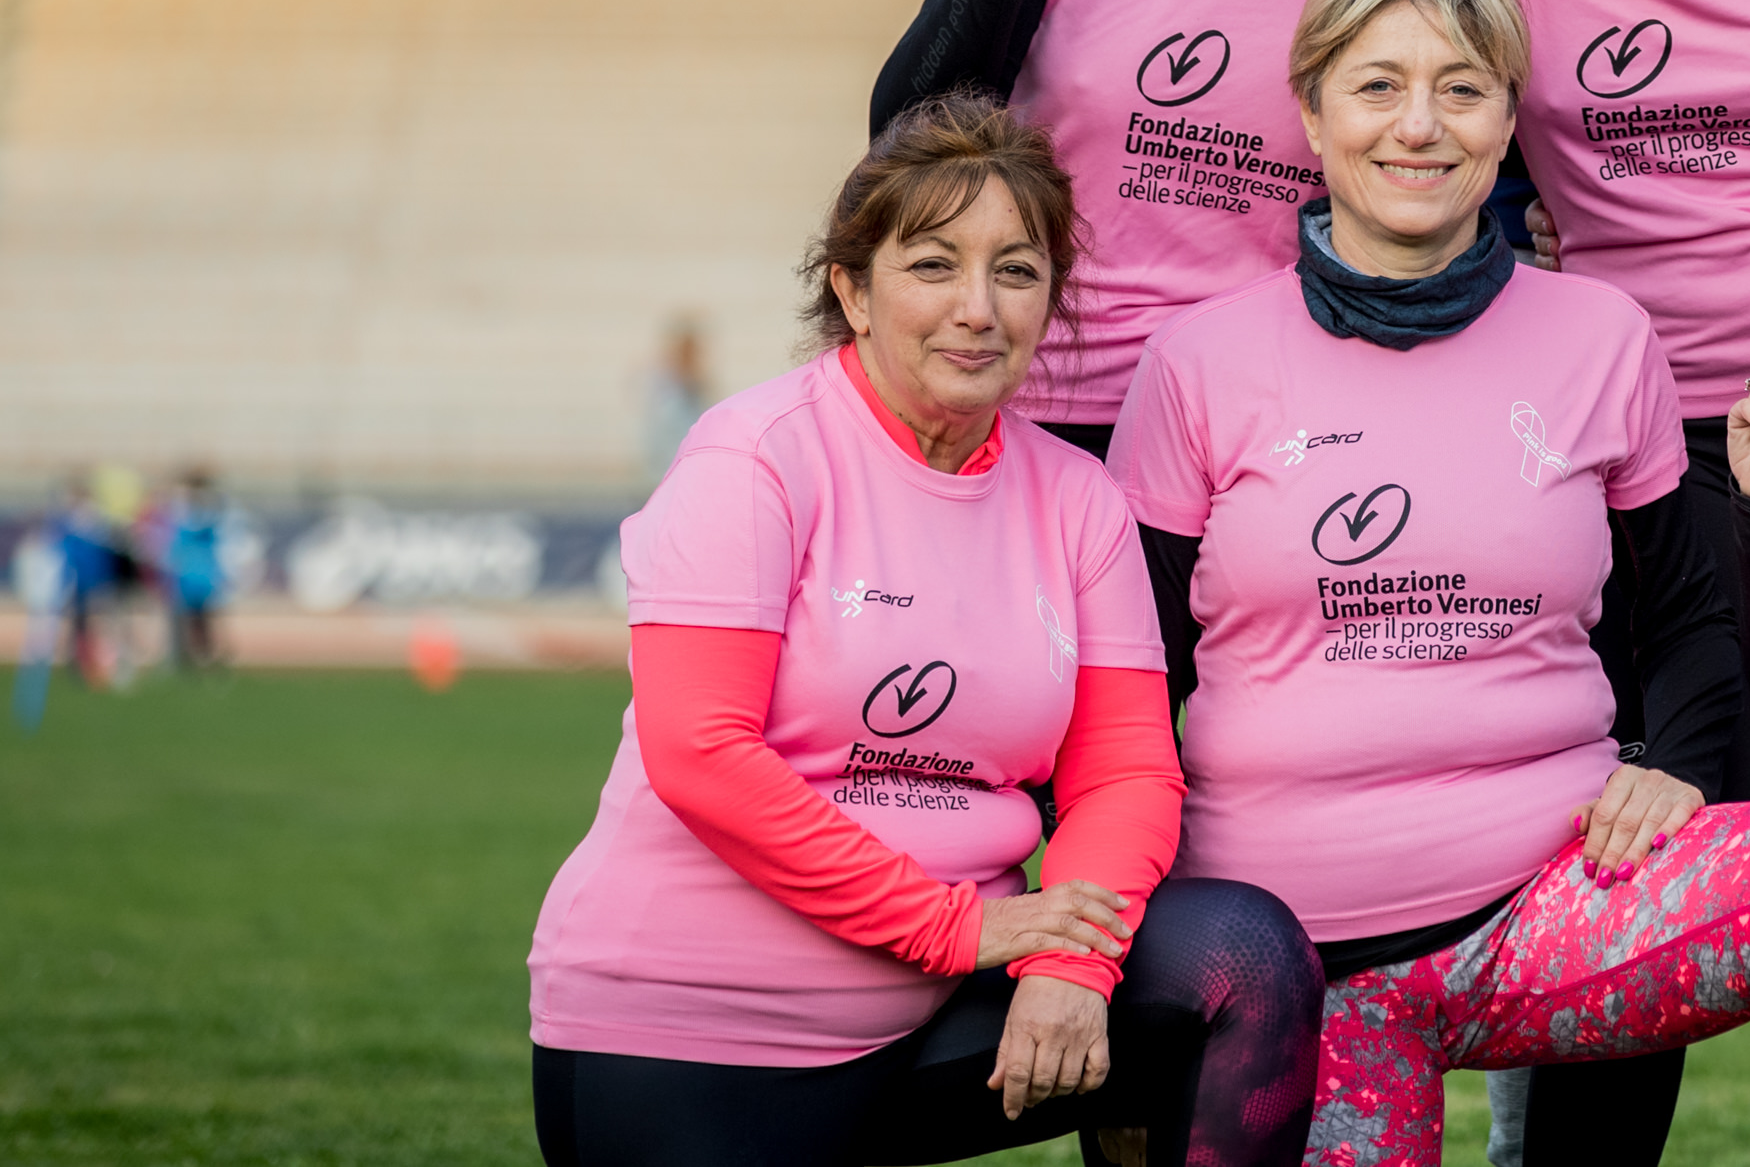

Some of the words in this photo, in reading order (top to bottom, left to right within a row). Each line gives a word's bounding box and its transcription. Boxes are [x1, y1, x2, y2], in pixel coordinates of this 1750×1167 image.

[910, 26, 953, 96] hidden
[1582, 104, 1728, 126] Fondazione
[1128, 112, 1264, 151] Fondazione
[1585, 122, 1696, 142] Umberto
[1650, 132, 1664, 156] il
[1125, 134, 1228, 167] Umberto
[1599, 157, 1651, 181] delle
[1656, 150, 1737, 174] scienze
[1118, 178, 1170, 204] delle
[1173, 186, 1251, 214] scienze
[1178, 163, 1189, 183] il
[1192, 169, 1299, 204] progresso
[1522, 432, 1539, 451] Pink
[1544, 455, 1567, 469] good
[1317, 570, 1466, 598] Fondazione
[1321, 595, 1432, 620] Umberto
[1437, 593, 1542, 615] Veronesi
[1385, 617, 1396, 639] il
[1401, 621, 1513, 643] progresso
[1324, 641, 1377, 662] delle
[1382, 640, 1467, 661] scienze
[848, 741, 974, 775] Fondazione
[834, 786, 889, 806] delle
[895, 790, 970, 811] scienze
